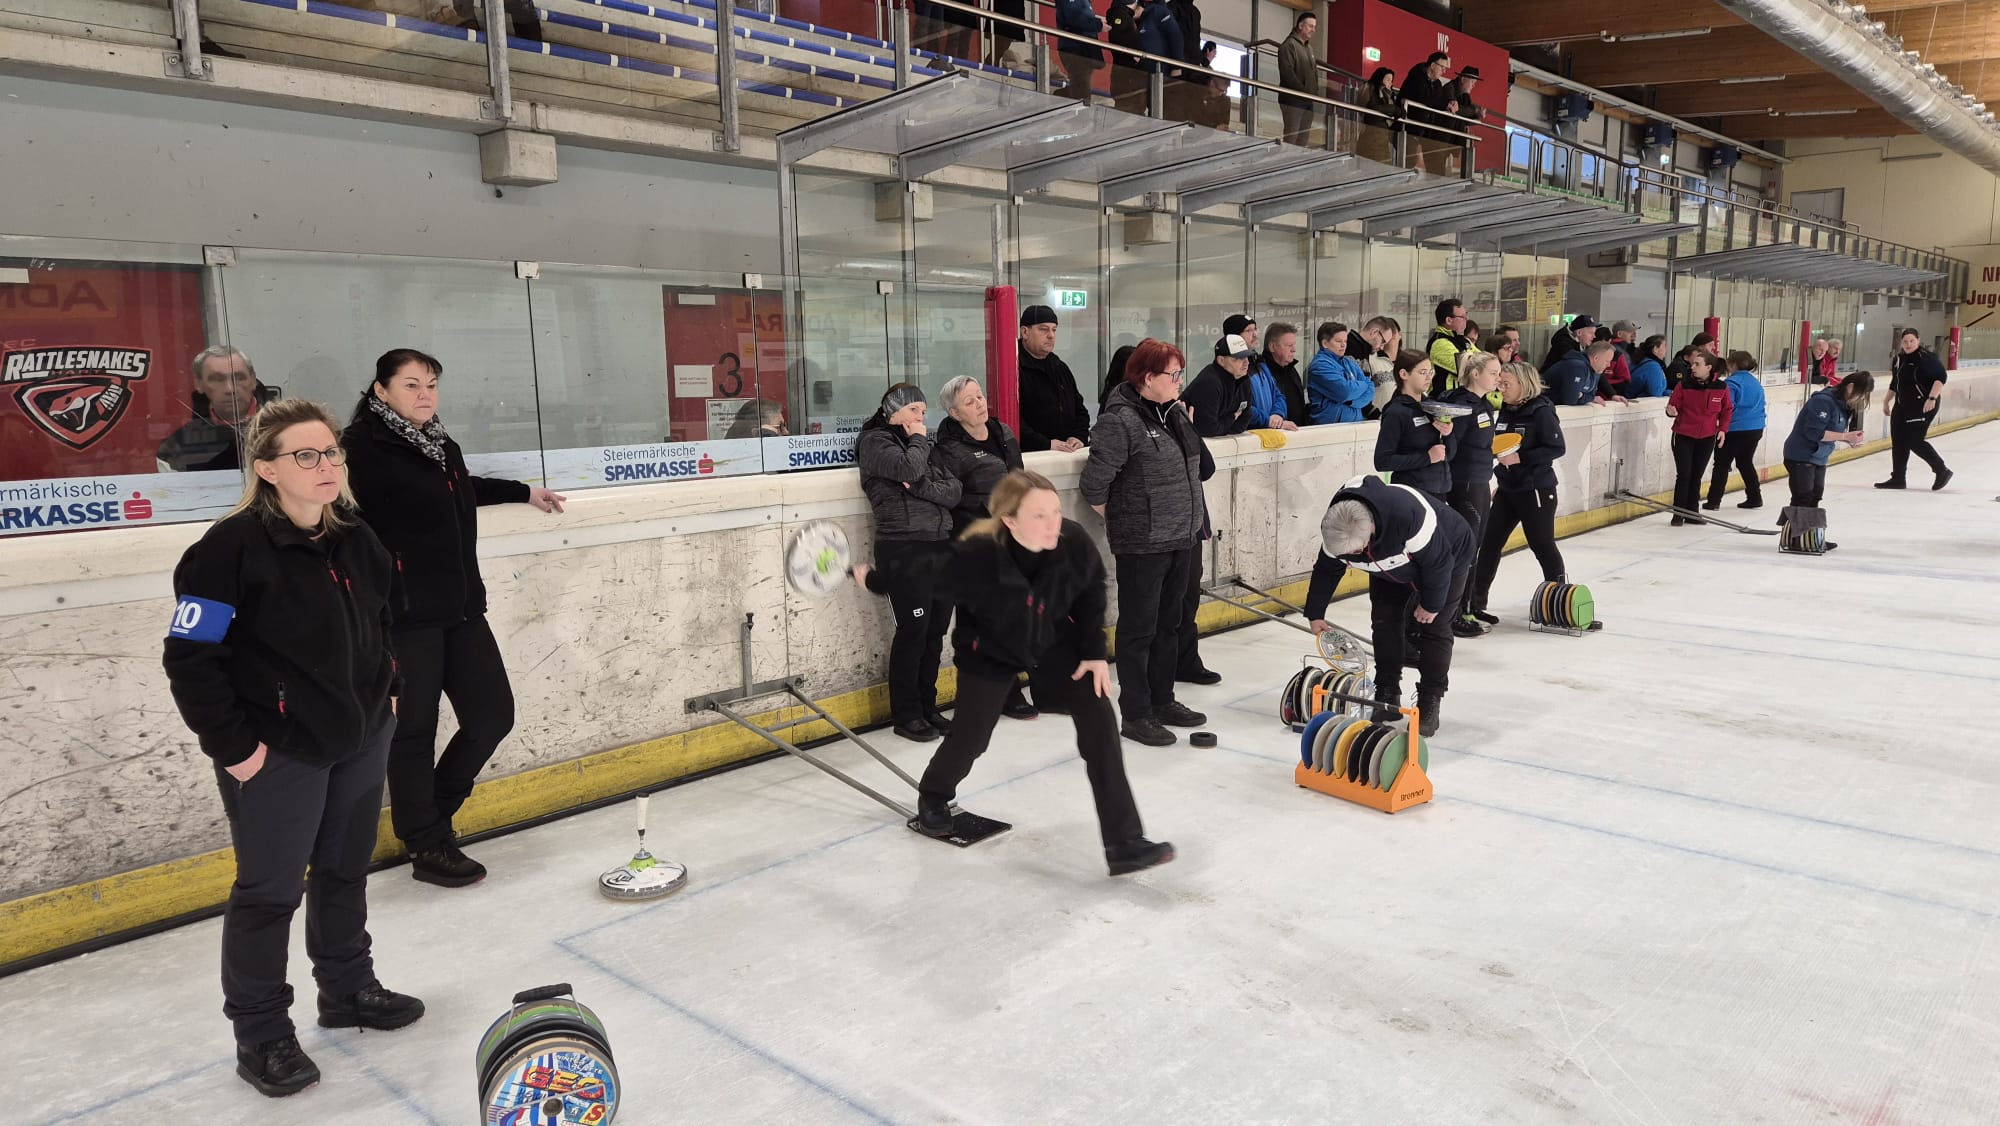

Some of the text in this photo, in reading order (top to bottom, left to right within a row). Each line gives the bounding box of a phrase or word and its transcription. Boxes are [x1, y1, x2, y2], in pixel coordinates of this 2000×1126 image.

[1437, 32, 1450, 53] WC
[1967, 290, 2000, 309] Jug
[4, 350, 147, 381] RATTLESNAKES
[719, 352, 743, 398] 3
[788, 435, 857, 449] Steiermärkisch
[603, 444, 696, 462] Steiermärkische
[788, 449, 858, 467] SPARKASS
[604, 460, 697, 482] SPARKASSE
[174, 600, 202, 629] 10
